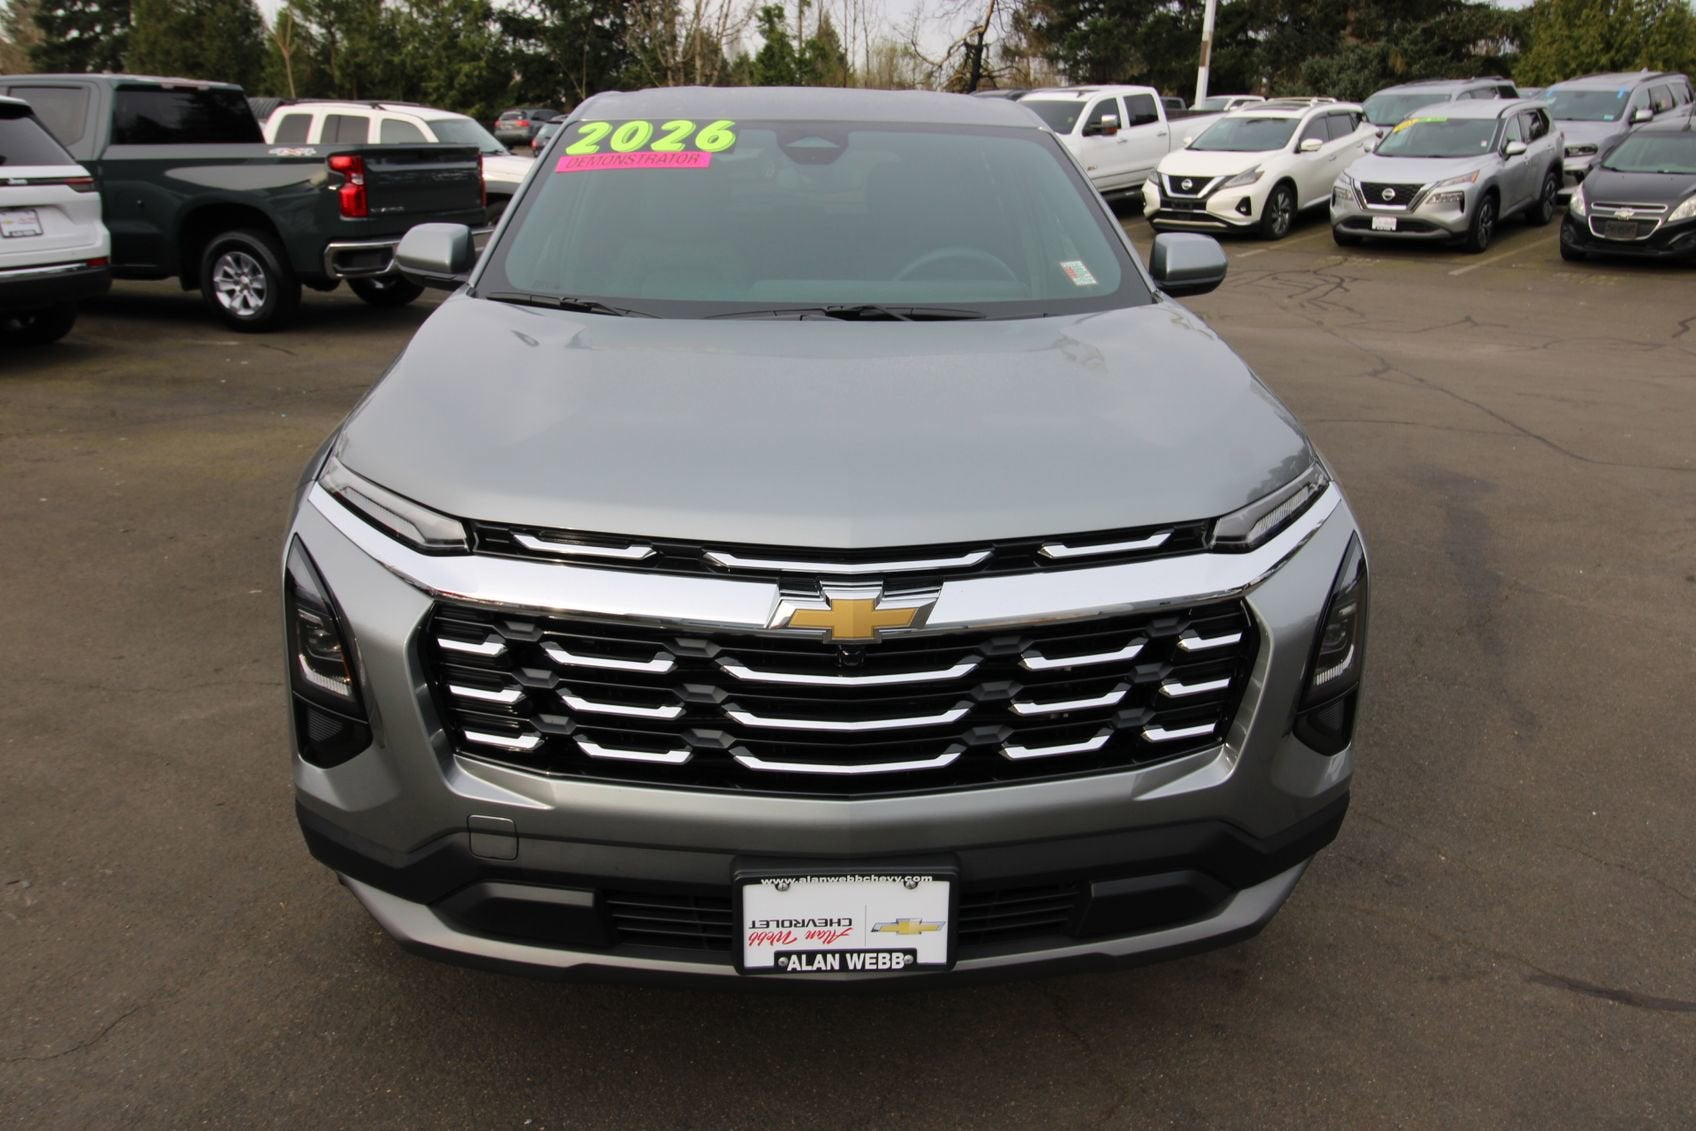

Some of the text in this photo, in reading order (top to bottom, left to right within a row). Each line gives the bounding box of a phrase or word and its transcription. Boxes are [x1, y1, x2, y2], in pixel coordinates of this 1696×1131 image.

[566, 120, 736, 155] 2026
[566, 153, 700, 169] DEMONSTRATOR
[761, 875, 933, 885] www.alanwebbchevy.com
[749, 917, 853, 929] CHEVROLET
[749, 928, 853, 947] Alan Webb
[787, 952, 905, 971] ALAN WEBB
